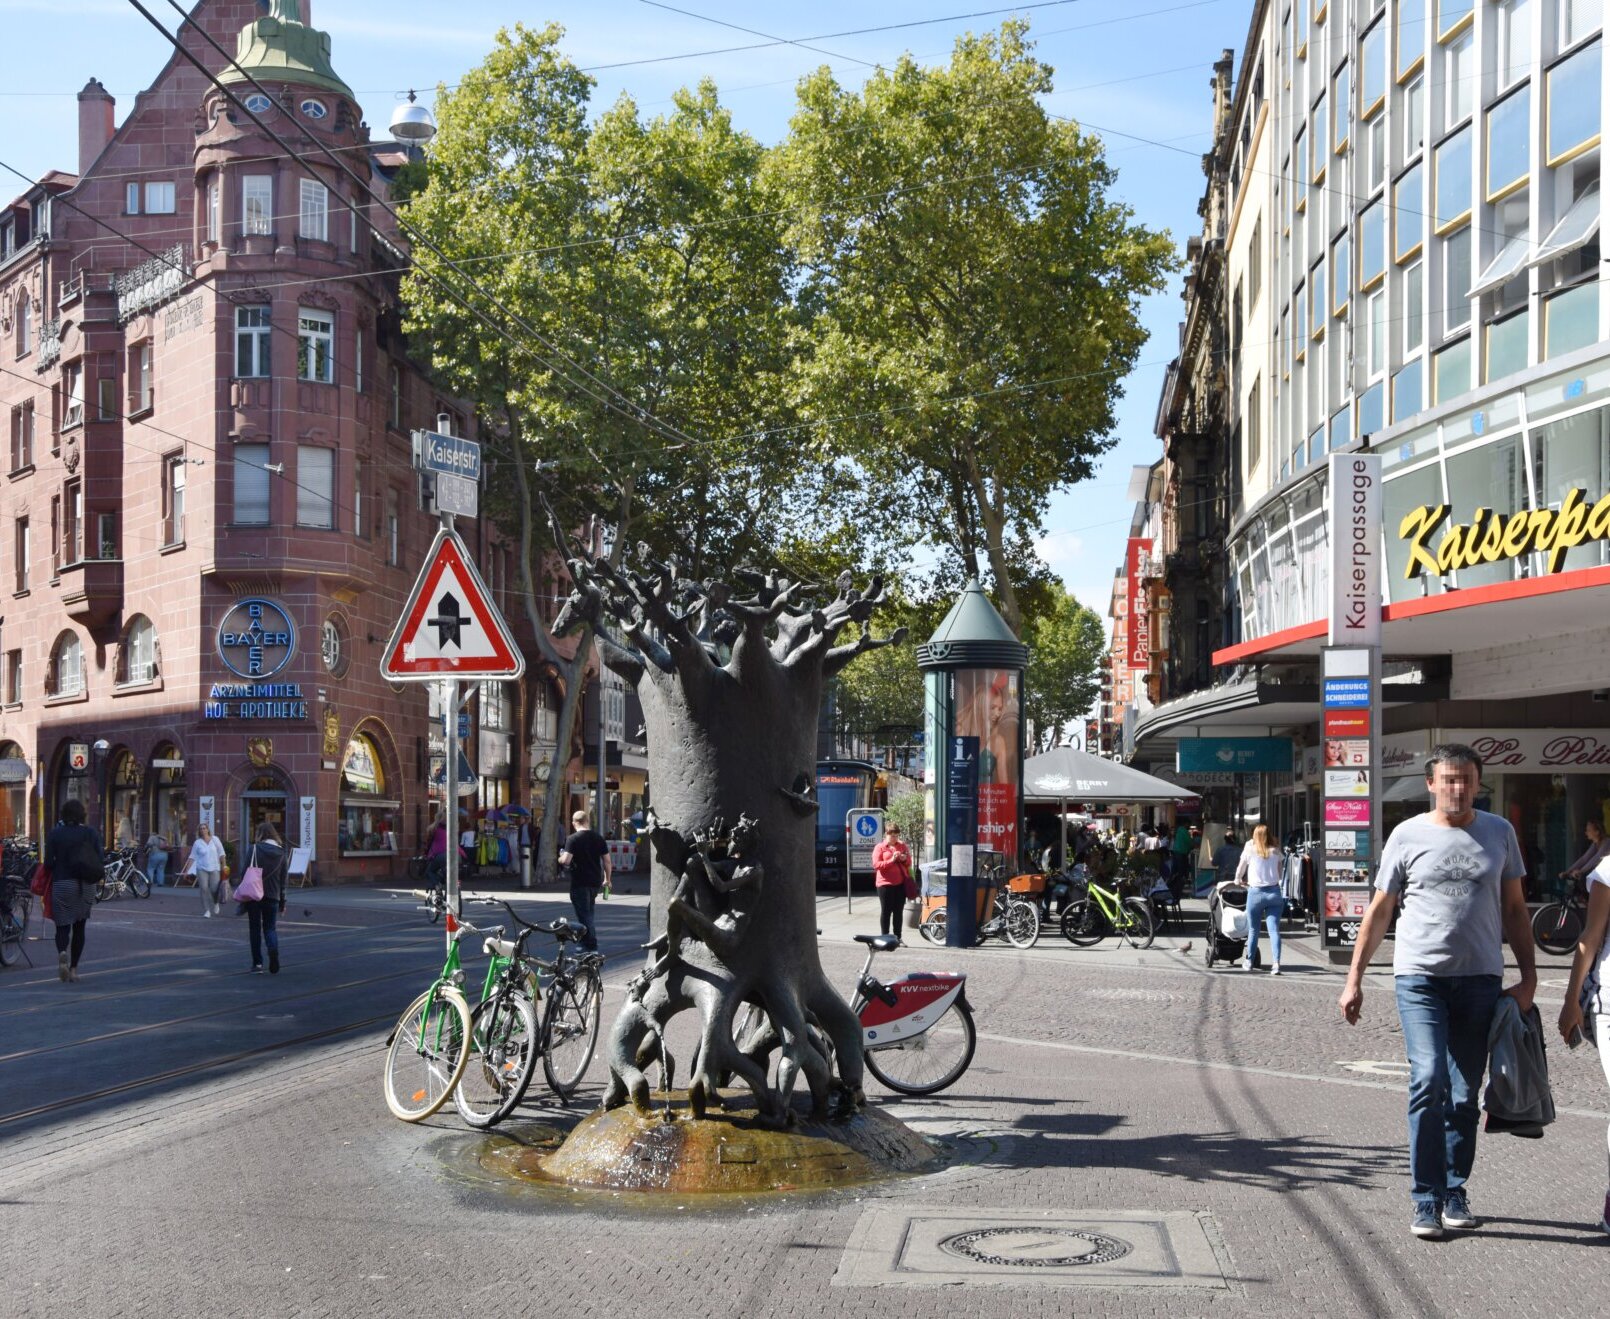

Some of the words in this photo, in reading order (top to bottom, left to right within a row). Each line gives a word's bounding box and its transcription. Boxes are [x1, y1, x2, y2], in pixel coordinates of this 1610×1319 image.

[427, 439, 478, 471] Kaiserstr.
[1346, 459, 1372, 629] Kaiserpassage
[223, 632, 289, 646] BAYER
[249, 604, 263, 674] BAYER
[1325, 693, 1368, 702] SCHNEIDEREI
[239, 701, 307, 718] APOTHEKE
[858, 837, 876, 845] ZONE
[824, 856, 838, 864] 331
[901, 985, 918, 993] KVV
[919, 984, 950, 992] nextbike
